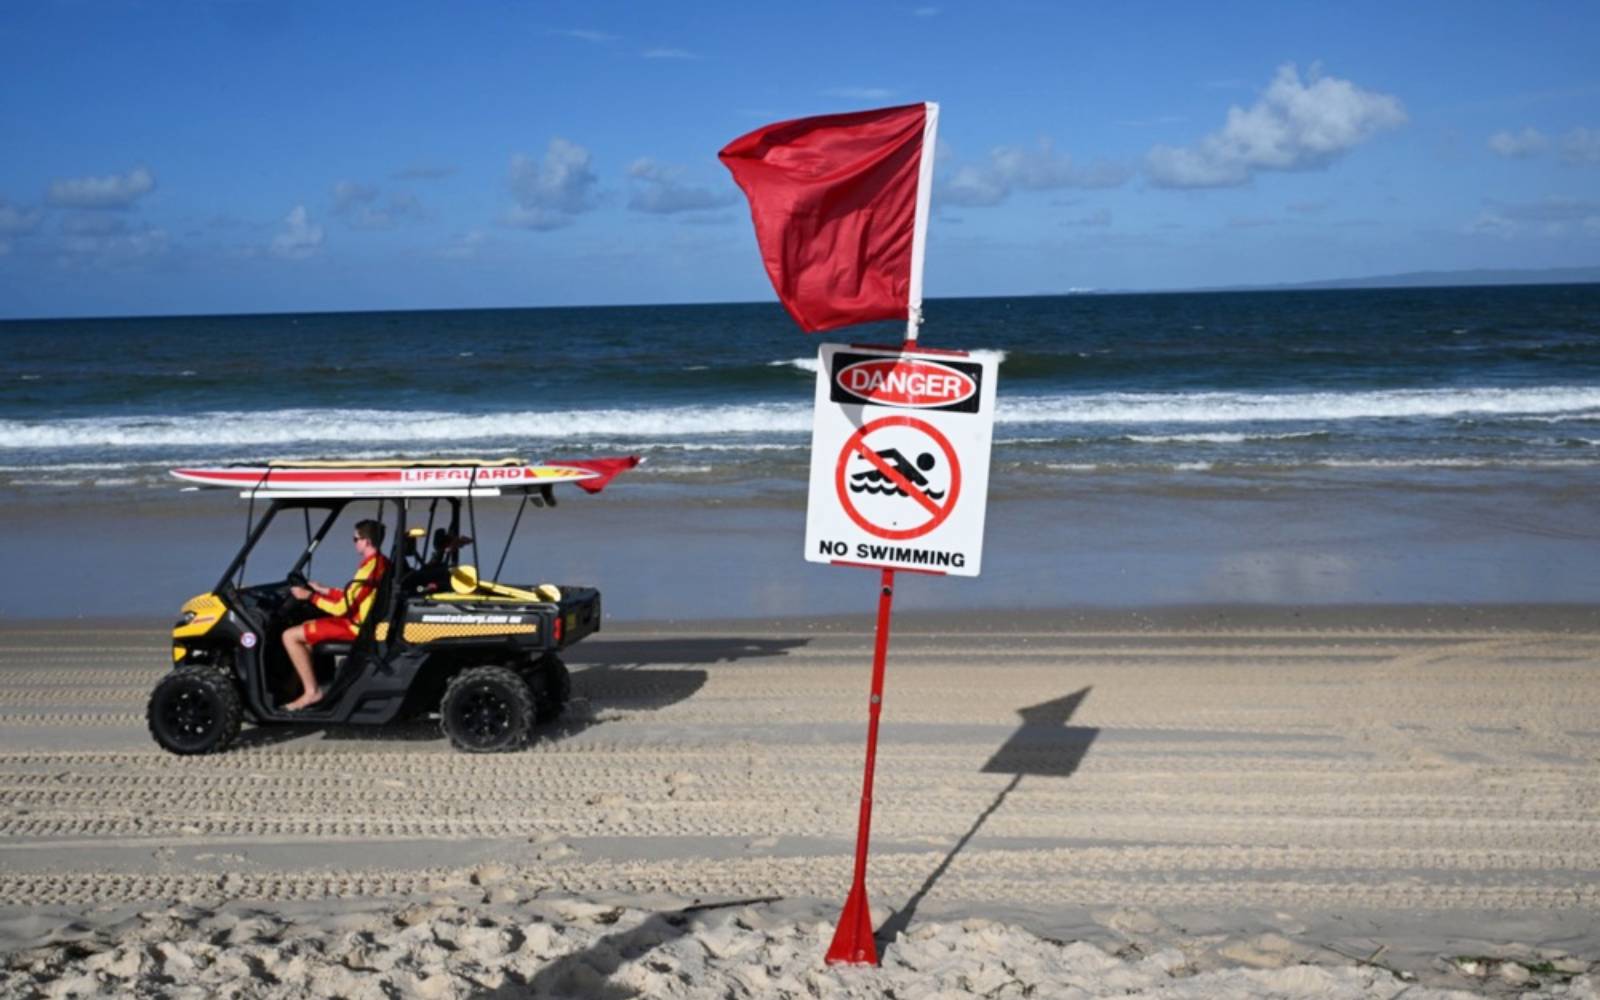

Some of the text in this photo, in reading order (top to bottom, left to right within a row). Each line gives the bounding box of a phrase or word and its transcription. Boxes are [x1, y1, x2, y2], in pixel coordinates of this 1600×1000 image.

[852, 369, 961, 397] DANGER
[405, 468, 521, 481] LIFEGUARD
[819, 540, 965, 567] NO SWIMMING
